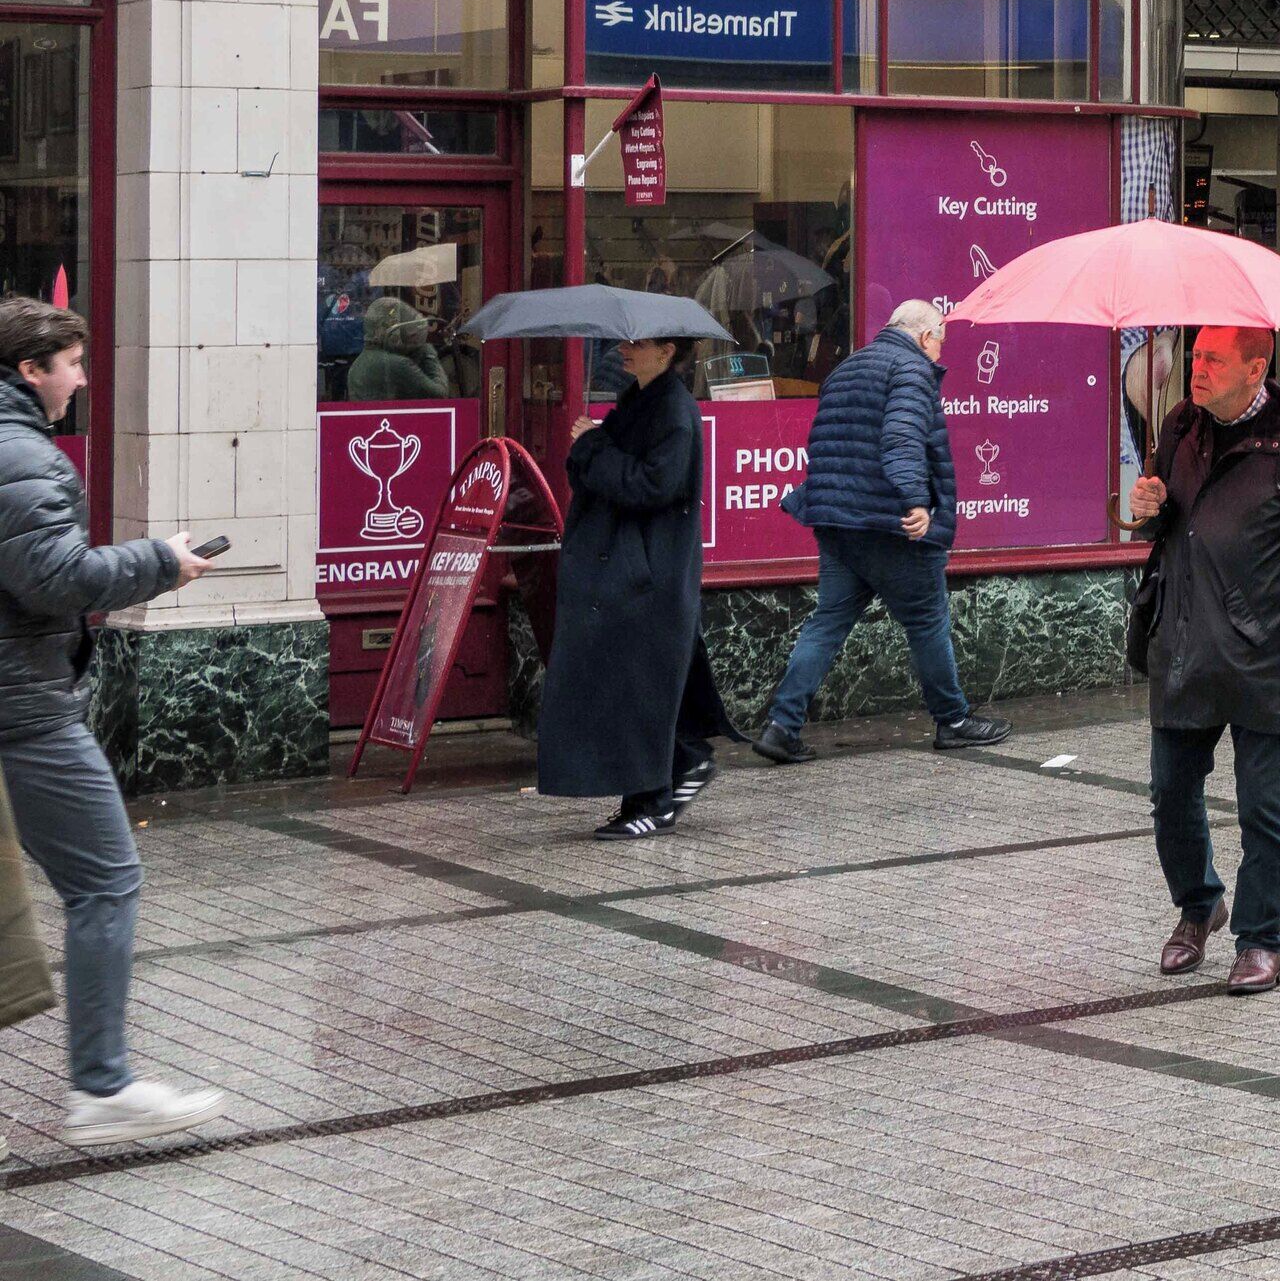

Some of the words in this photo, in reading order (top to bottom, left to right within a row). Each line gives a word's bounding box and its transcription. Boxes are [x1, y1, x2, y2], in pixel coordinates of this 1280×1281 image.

[636, 158, 657, 170] Engraving
[628, 175, 640, 185] Phone
[641, 174, 657, 186] Repairs
[938, 196, 968, 220] Key
[974, 196, 1037, 220] Cutting
[941, 395, 980, 415] atch
[988, 394, 1048, 418] Repairs
[736, 447, 809, 473] PHON
[459, 461, 503, 501] TIMPSON
[956, 494, 1029, 519] ngraving
[431, 553, 452, 571] KEY
[451, 553, 481, 572] FOBS
